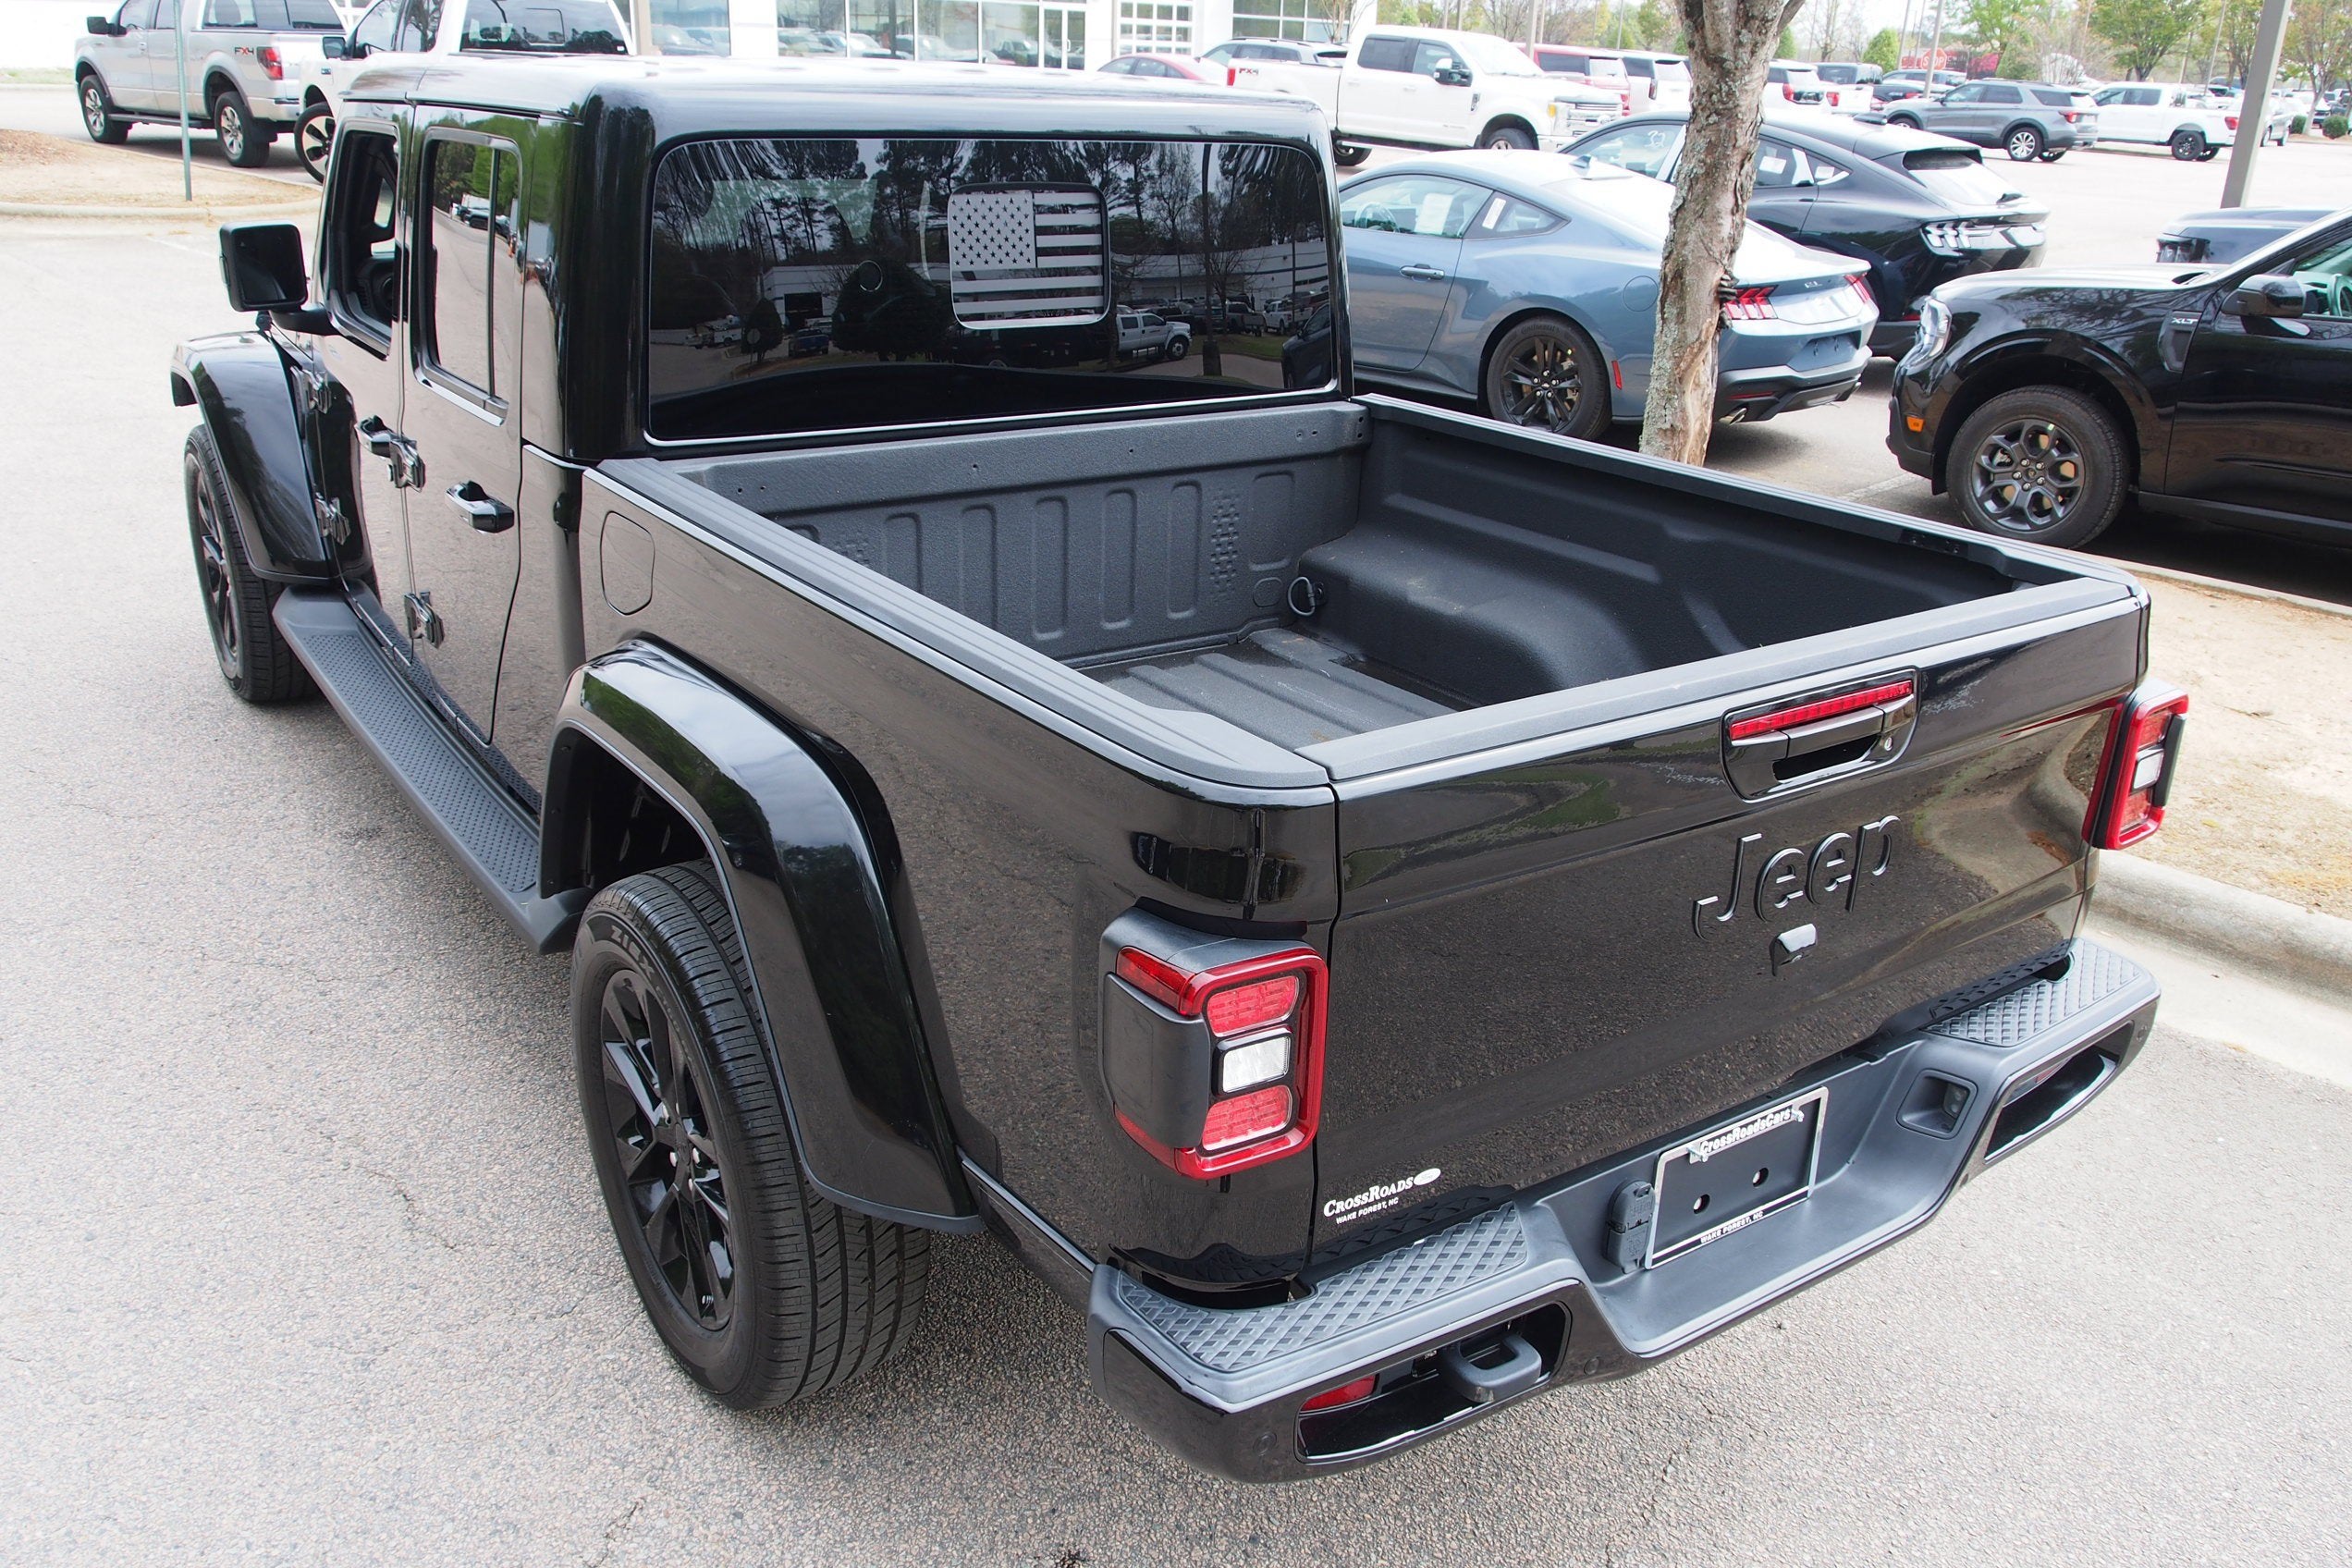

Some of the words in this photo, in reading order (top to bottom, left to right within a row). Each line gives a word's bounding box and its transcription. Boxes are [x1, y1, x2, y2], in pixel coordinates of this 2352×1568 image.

[1923, 56, 1944, 67] SOP
[1693, 815, 1902, 941] Jeep
[1336, 1211, 1357, 1224] WAKE
[1358, 1201, 1388, 1217] FOREST,
[1388, 1197, 1399, 1207] NC
[1700, 1230, 1721, 1243] WAKE
[1753, 1211, 1764, 1220] NC
